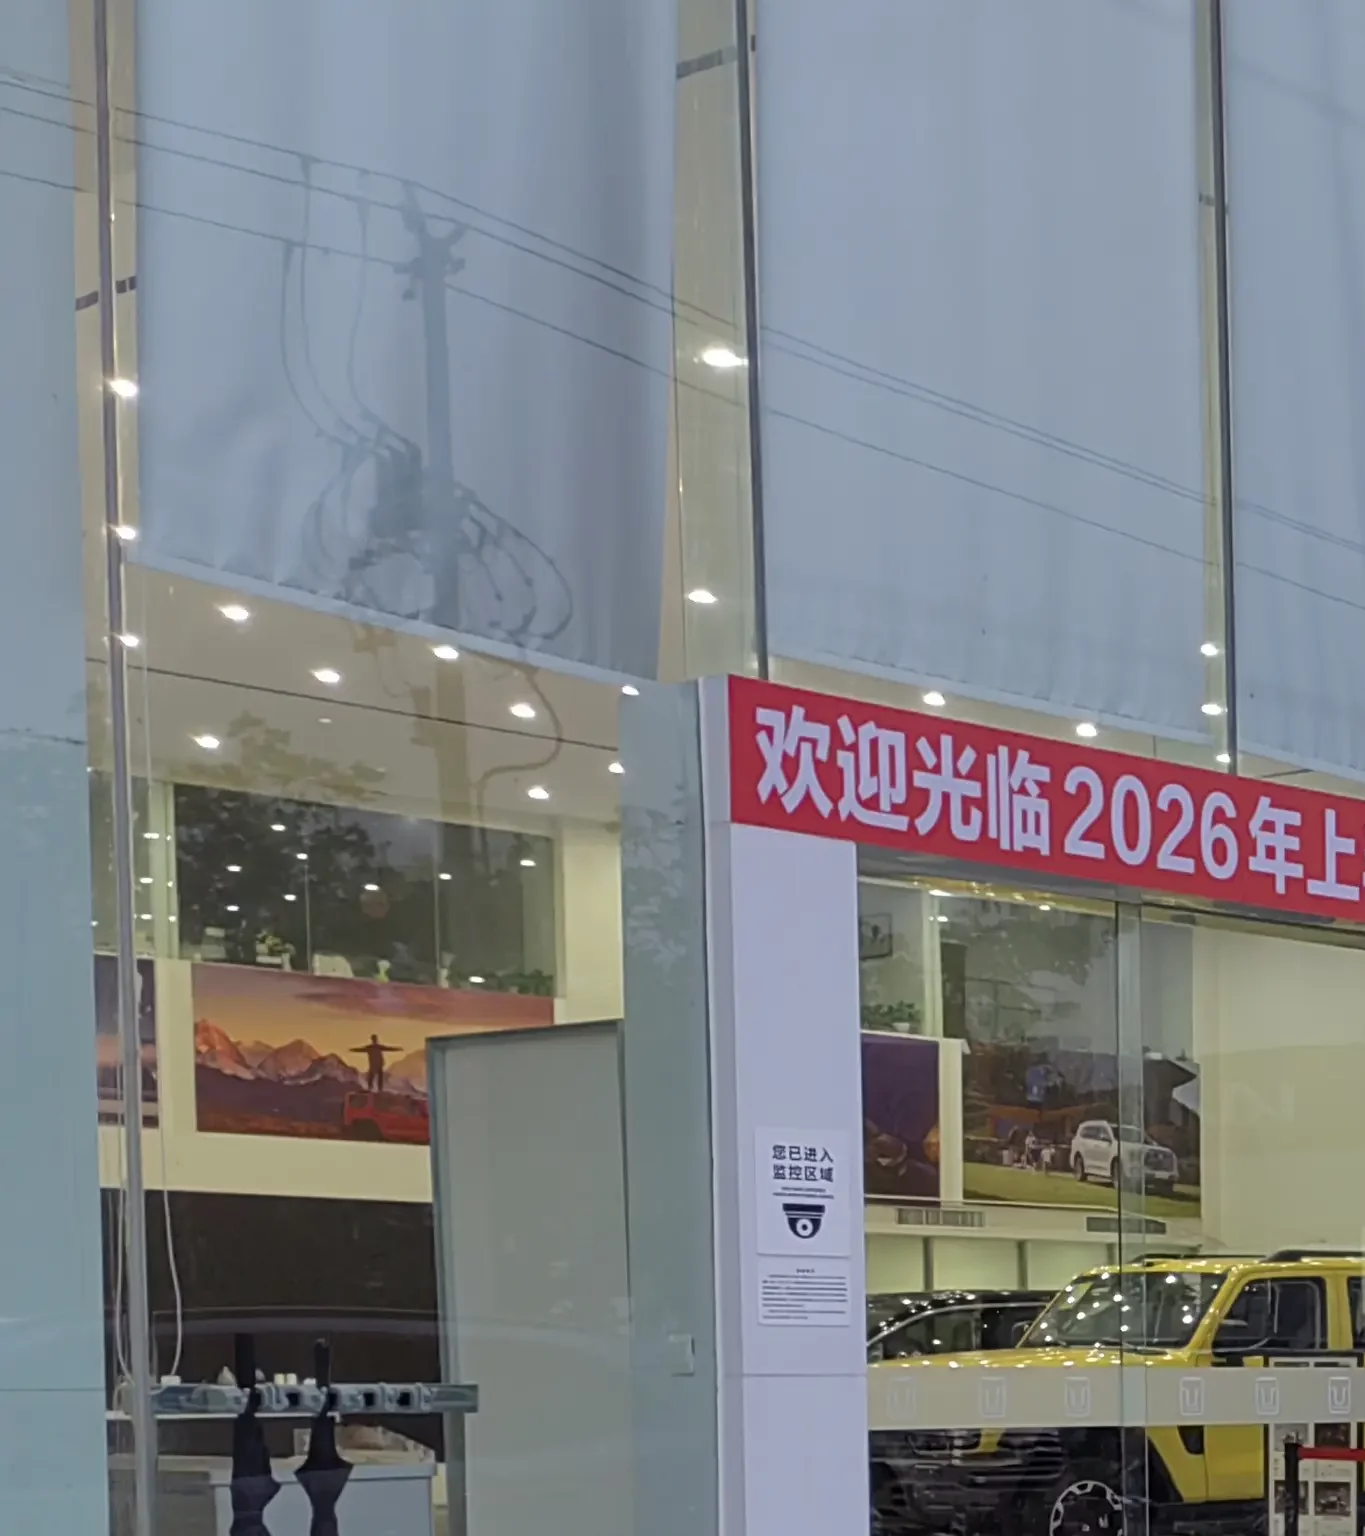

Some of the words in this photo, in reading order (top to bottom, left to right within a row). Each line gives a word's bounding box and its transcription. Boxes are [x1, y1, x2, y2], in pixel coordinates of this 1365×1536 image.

[772, 1144, 834, 1163] 您已进入
[772, 1166, 834, 1183] 监控区域
